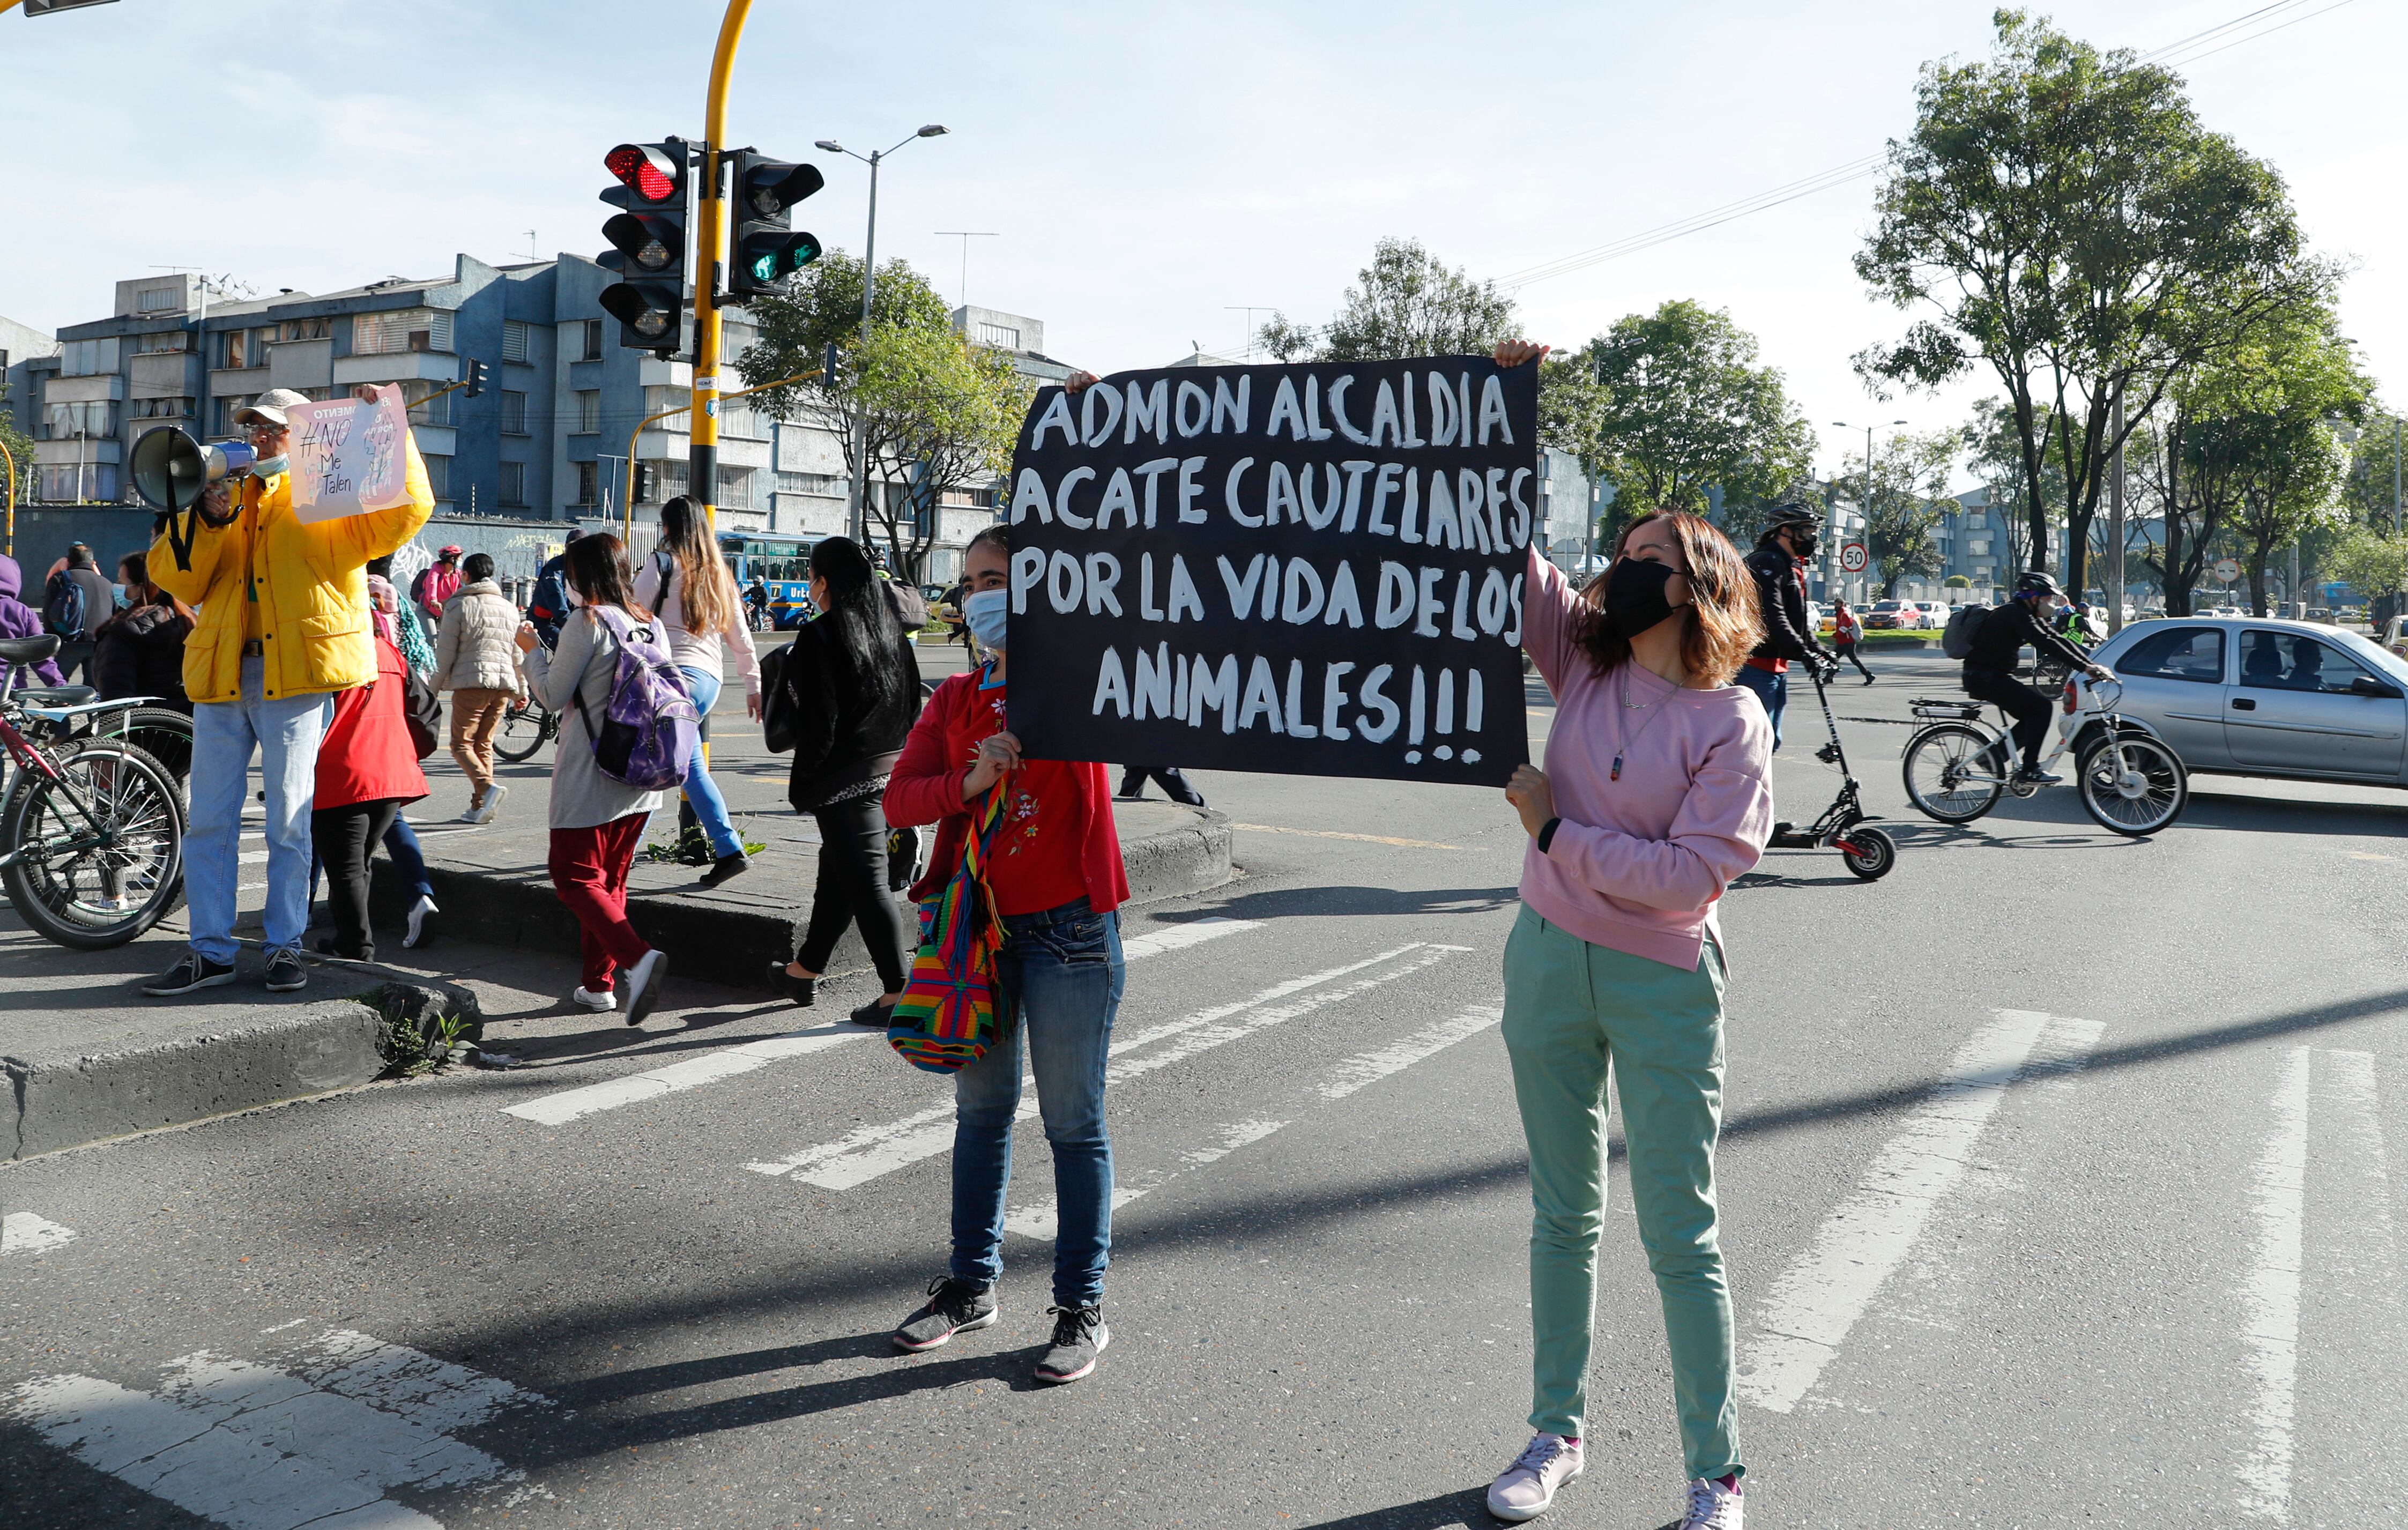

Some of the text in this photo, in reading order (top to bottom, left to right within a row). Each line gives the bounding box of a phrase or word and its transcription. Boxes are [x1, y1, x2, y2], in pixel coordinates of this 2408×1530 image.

[300, 419, 351, 458] #NO
[1031, 370, 1514, 451] ADMON ALCALDIA
[321, 453, 341, 473] Me
[323, 473, 351, 495] Talen
[1010, 456, 1532, 555] ACATE CAUTELARES
[1847, 552, 1862, 564] 50
[1010, 546, 1523, 647] POR LA VIDA DE LOS
[1092, 640, 1483, 765] ANIMALES!!!
